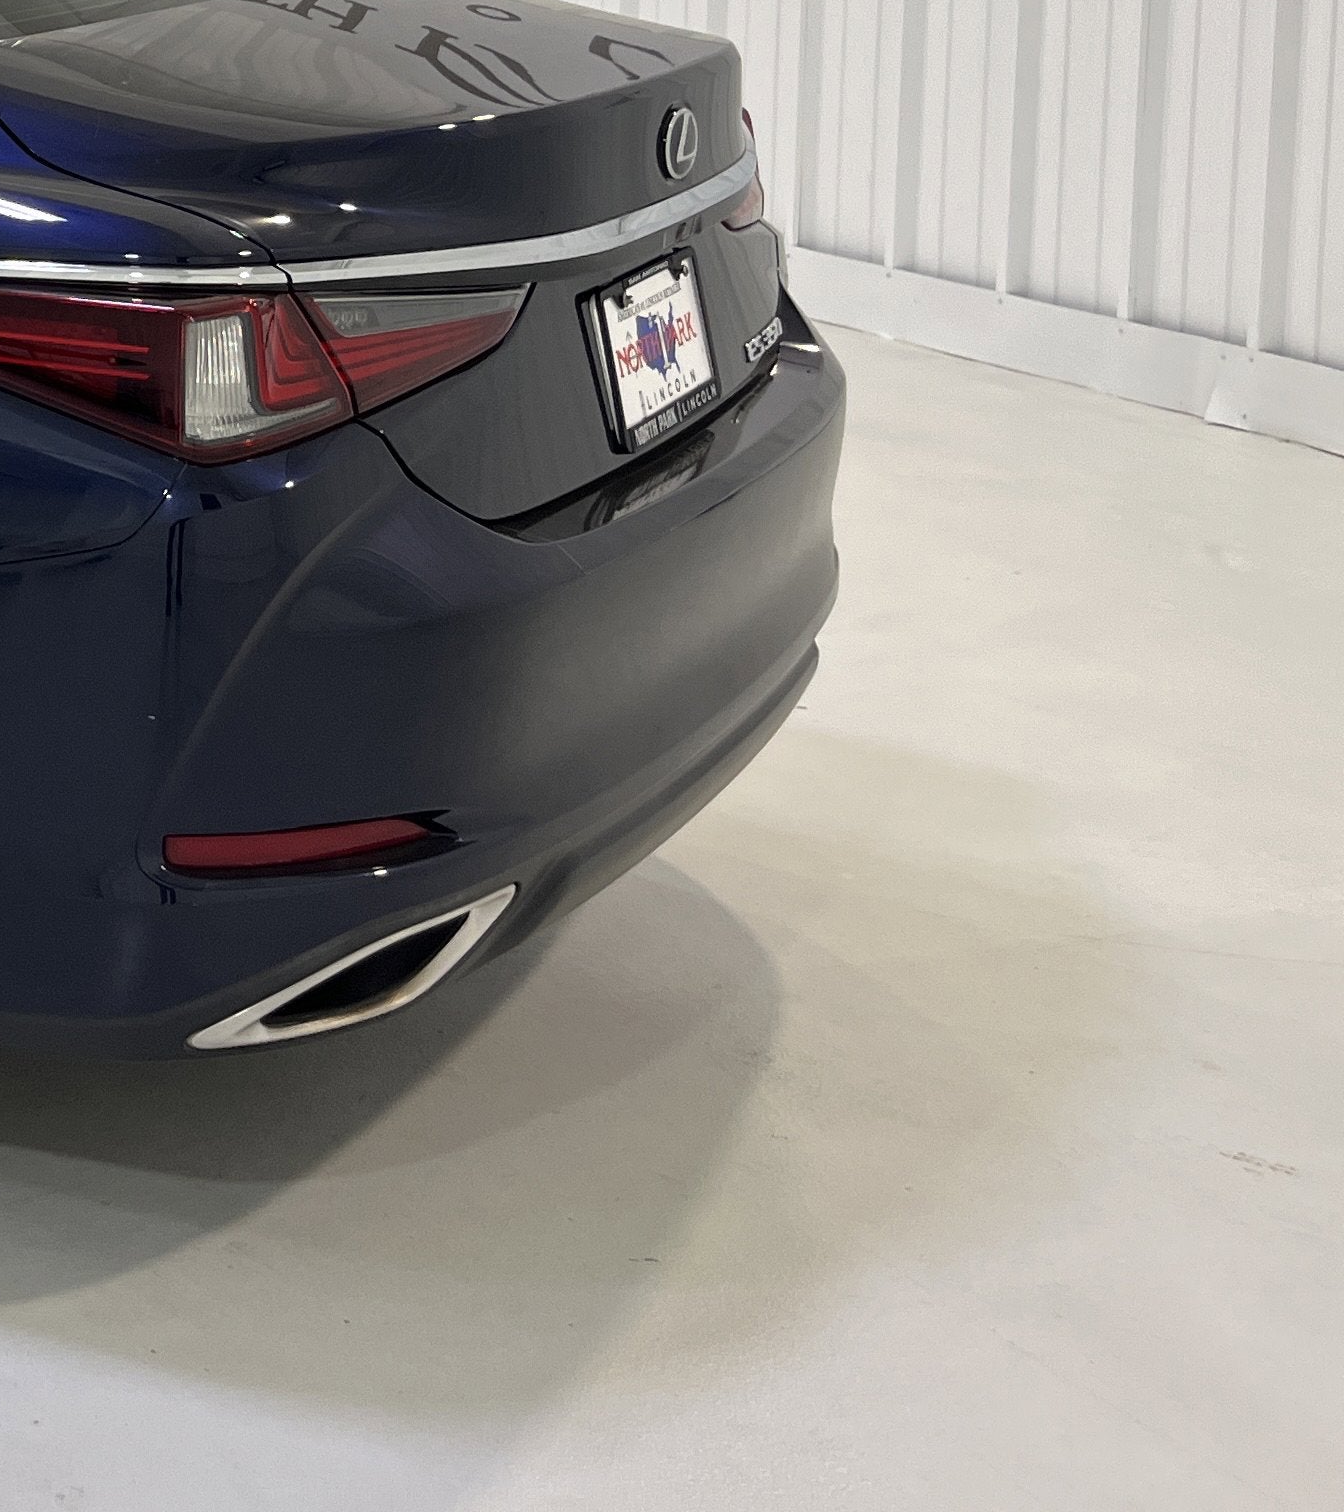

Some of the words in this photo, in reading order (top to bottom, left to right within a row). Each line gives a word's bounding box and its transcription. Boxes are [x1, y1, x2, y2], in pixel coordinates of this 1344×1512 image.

[615, 331, 660, 378] NORTH
[665, 312, 697, 349] PARK
[646, 369, 697, 410] LINCOLN
[681, 383, 718, 416] LINCOLN
